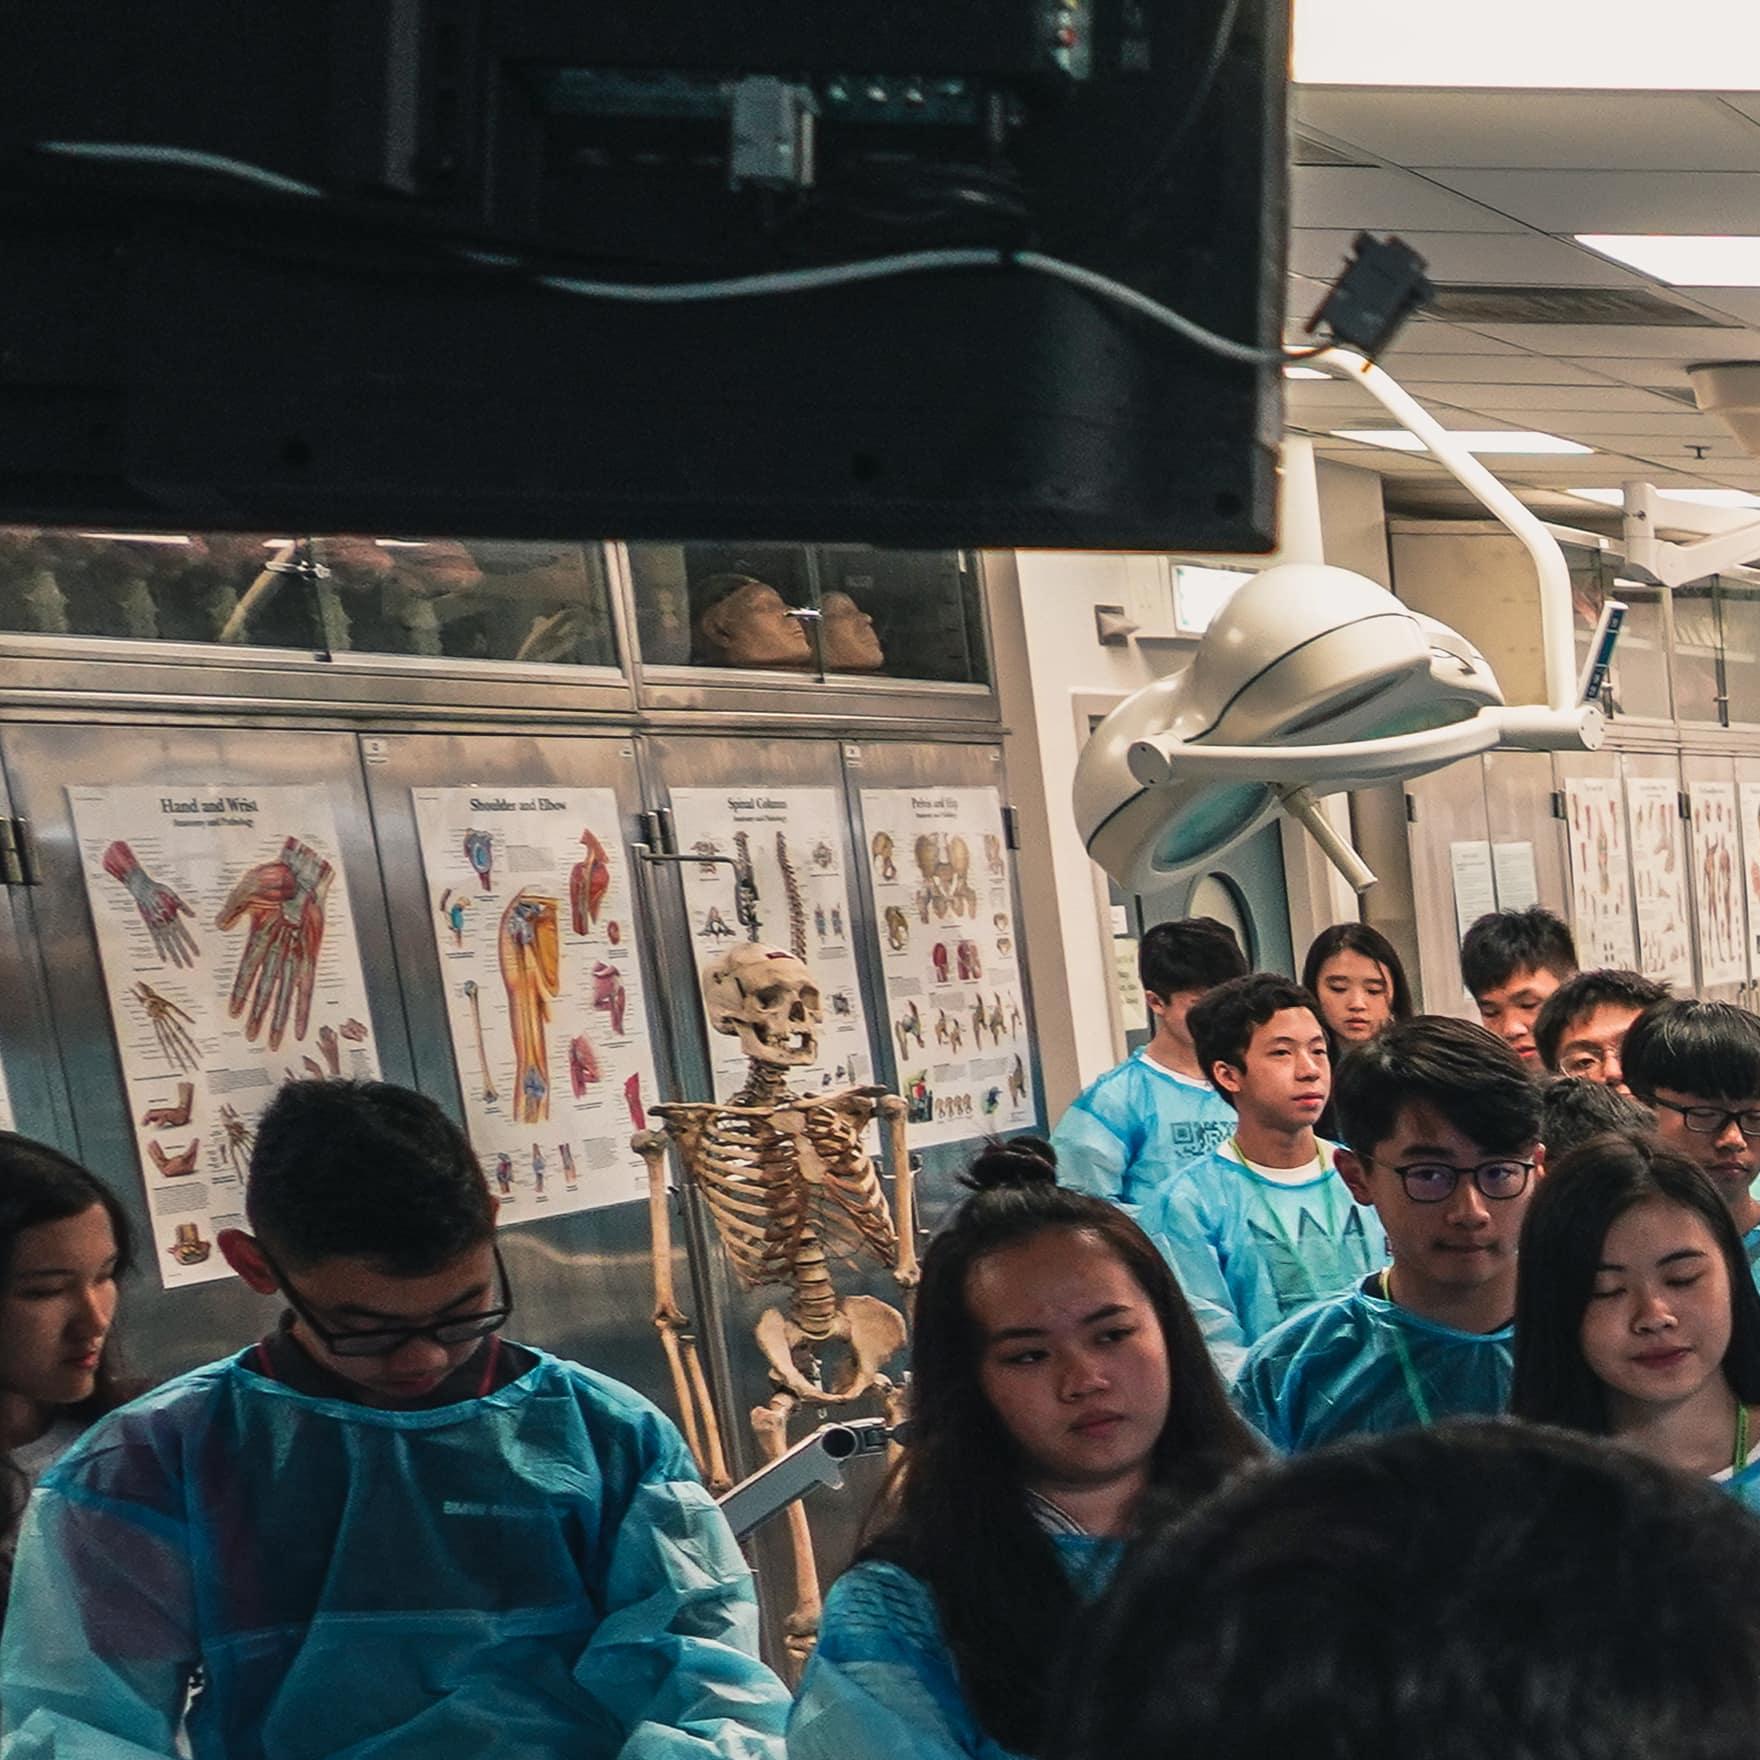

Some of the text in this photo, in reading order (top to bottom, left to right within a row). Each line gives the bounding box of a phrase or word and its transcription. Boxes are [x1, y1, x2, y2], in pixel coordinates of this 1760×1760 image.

[160, 797, 259, 813] Hand and Wrist
[470, 798, 567, 812] Shoulder and Elbow
